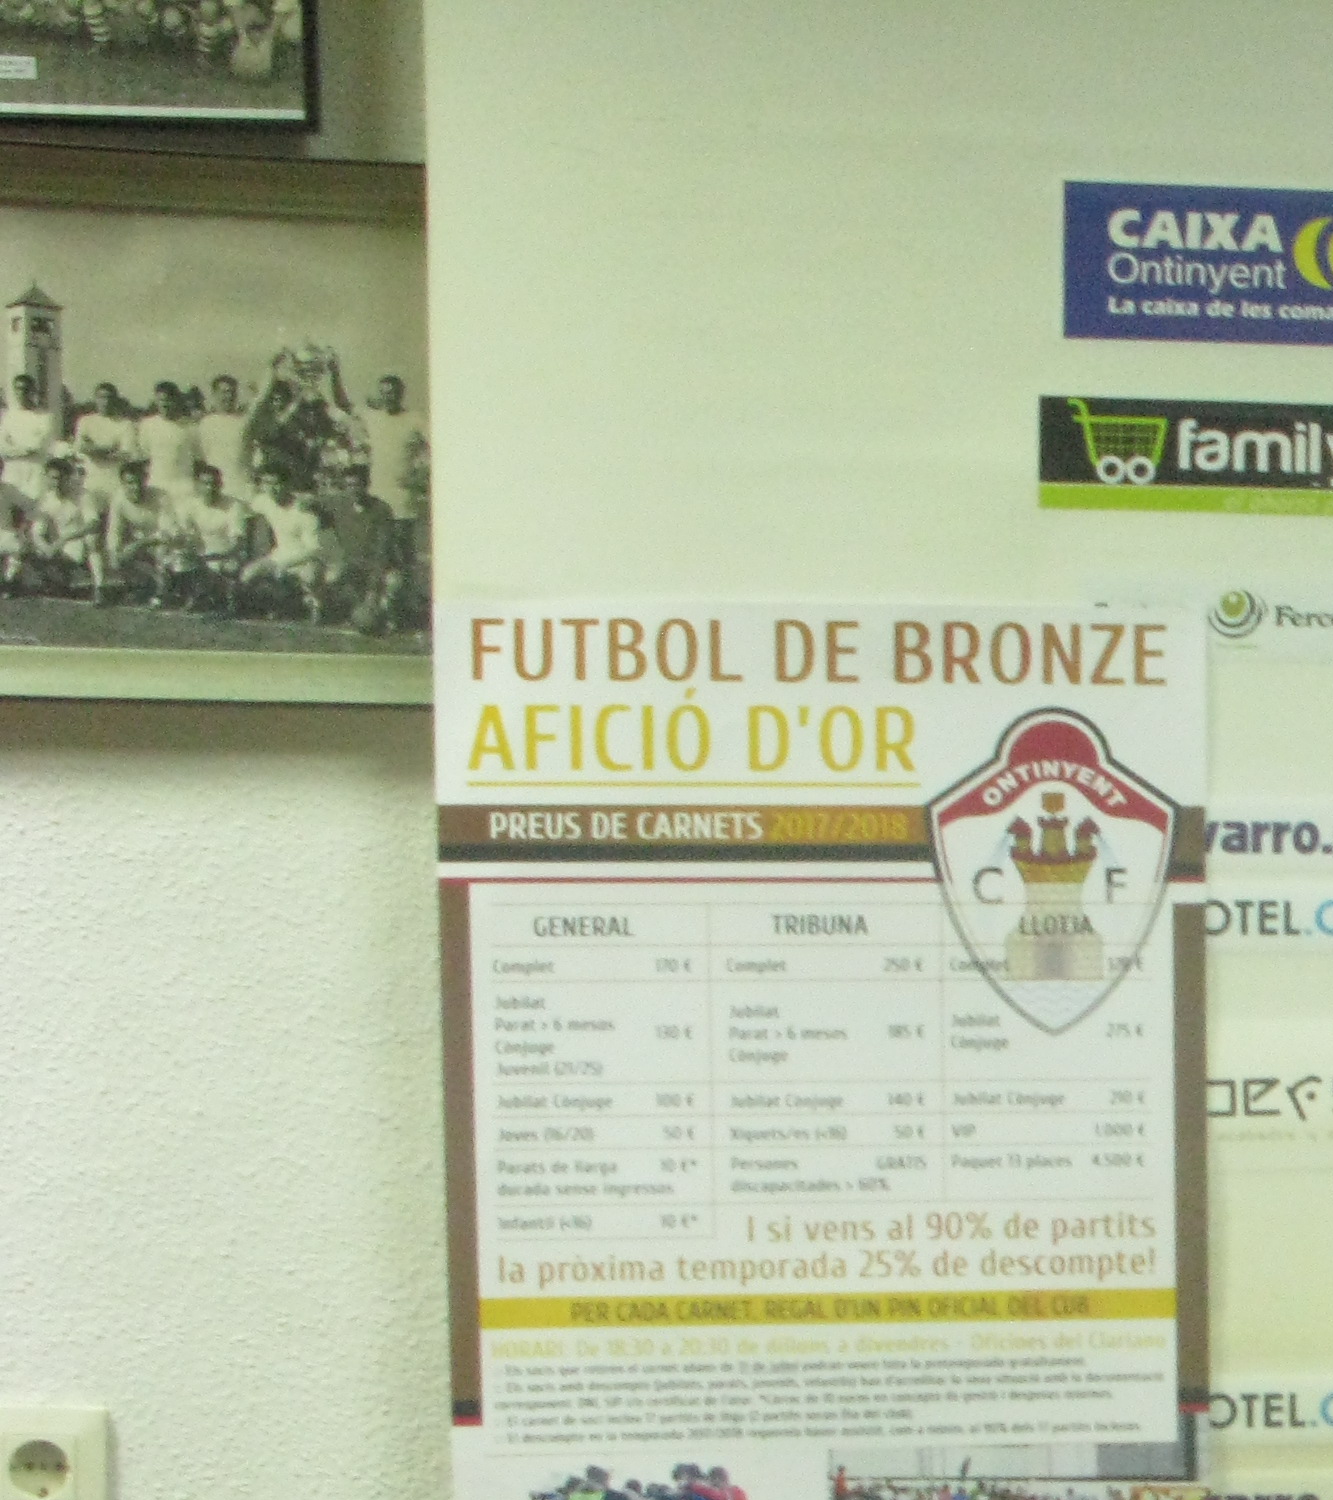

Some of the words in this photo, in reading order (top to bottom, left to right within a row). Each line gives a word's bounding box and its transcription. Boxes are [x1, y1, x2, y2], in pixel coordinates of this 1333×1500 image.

[1108, 208, 1283, 252] CAIXA
[1107, 253, 1287, 296] Ontinyent
[1108, 297, 1136, 315] La
[1142, 299, 1199, 317] caixa
[1206, 300, 1234, 318] de
[1241, 301, 1272, 320] les
[471, 617, 744, 684] FUTBOL
[774, 619, 860, 685] DE
[892, 620, 1168, 687] BRONZE
[467, 687, 711, 772] AFICIÓ
[748, 704, 916, 773] D'OR
[982, 759, 1128, 807] ONTINYENT
[489, 811, 582, 841] PREUS
[590, 812, 627, 840] DE
[637, 811, 764, 841] CARNETS
[768, 811, 910, 841] 2017/2018
[972, 866, 1005, 905] C
[1104, 867, 1128, 904] F
[533, 916, 635, 937] GENERAL
[772, 913, 868, 935] TRIBUNA
[492, 958, 554, 976] Complet
[726, 957, 786, 973] Complet
[767, 1215, 792, 1243] si
[804, 1218, 876, 1242] vens
[886, 1213, 913, 1241] al
[926, 1211, 992, 1240] 90%
[1003, 1212, 1039, 1241] de
[1051, 1211, 1156, 1246] partits
[498, 1254, 525, 1284] la
[538, 1254, 666, 1290] pròxima
[677, 1251, 848, 1287] temporada
[858, 1248, 921, 1279] 25%
[932, 1249, 968, 1278] de
[979, 1246, 1156, 1282] descompte!
[570, 1301, 610, 1324] PER
[616, 1301, 669, 1323] CADA
[765, 1297, 827, 1321] REGAL
[928, 1295, 1001, 1319] OFICIAL
